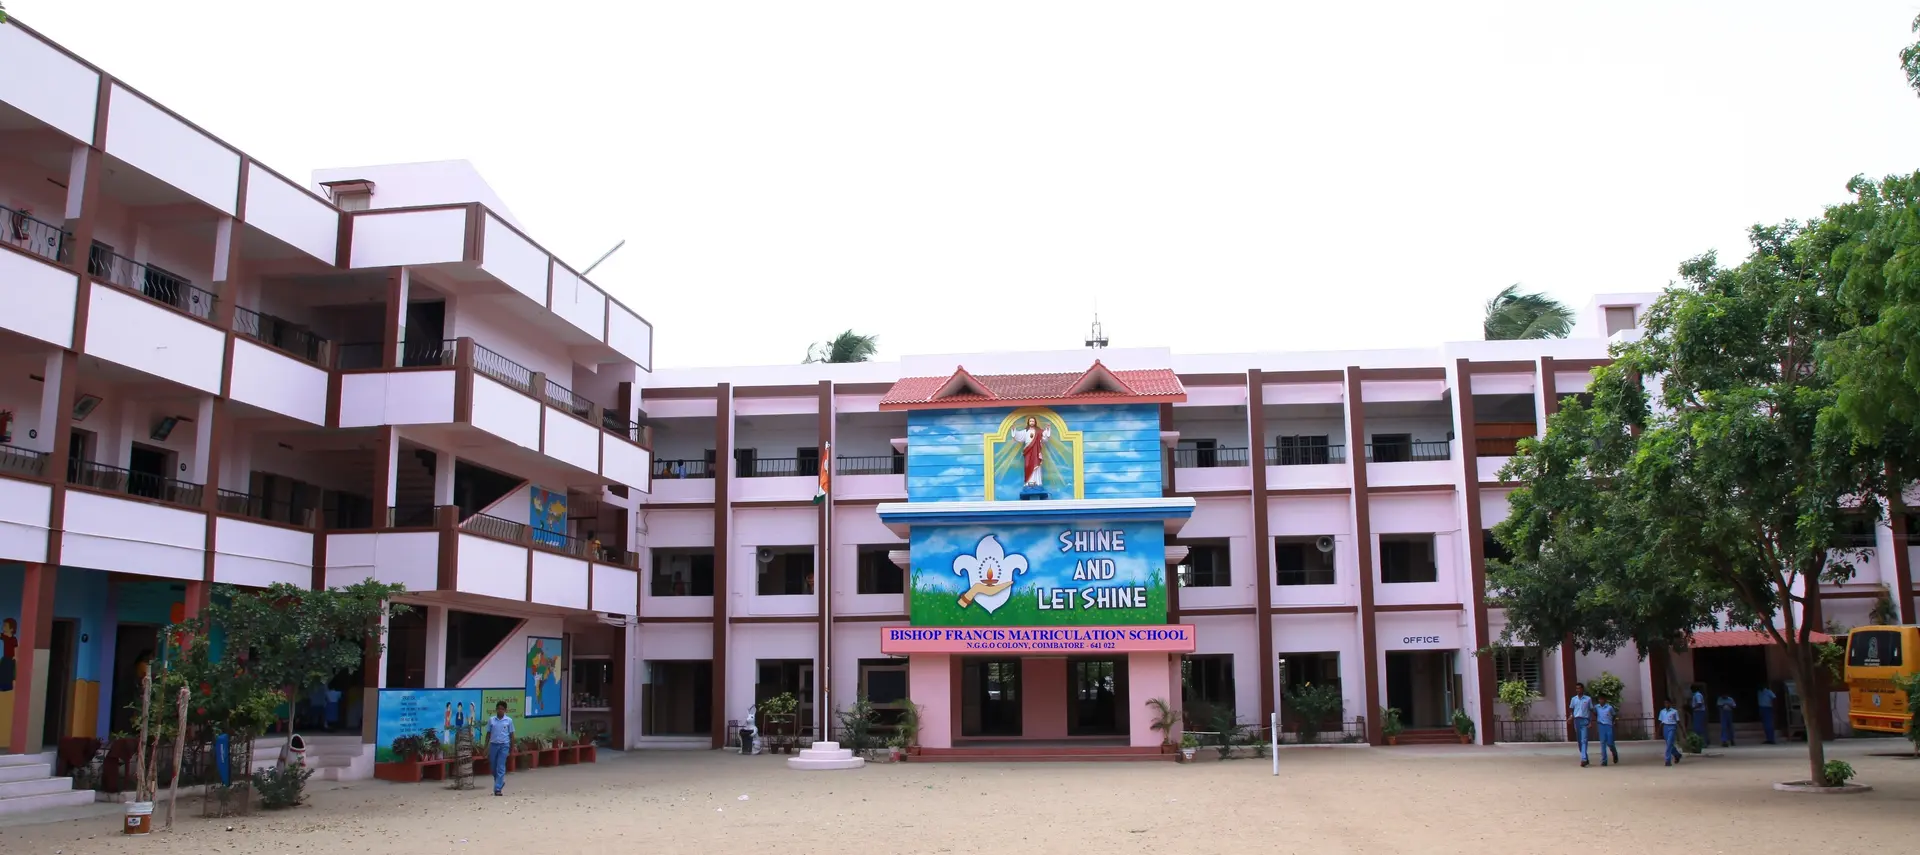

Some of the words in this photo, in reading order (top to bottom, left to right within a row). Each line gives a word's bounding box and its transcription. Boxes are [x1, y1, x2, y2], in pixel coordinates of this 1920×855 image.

[1059, 529, 1125, 553] SHINE
[1072, 558, 1116, 581] AND
[1037, 586, 1078, 610] LET
[1081, 586, 1147, 610] SHINE
[890, 629, 942, 641] BISHOP
[945, 629, 1005, 641] FRANCIS
[1008, 629, 1126, 641] MATRICULATION
[1129, 629, 1189, 641] SCHOOL
[1403, 635, 1440, 644] OFFICE
[997, 642, 1031, 650] COLONY,
